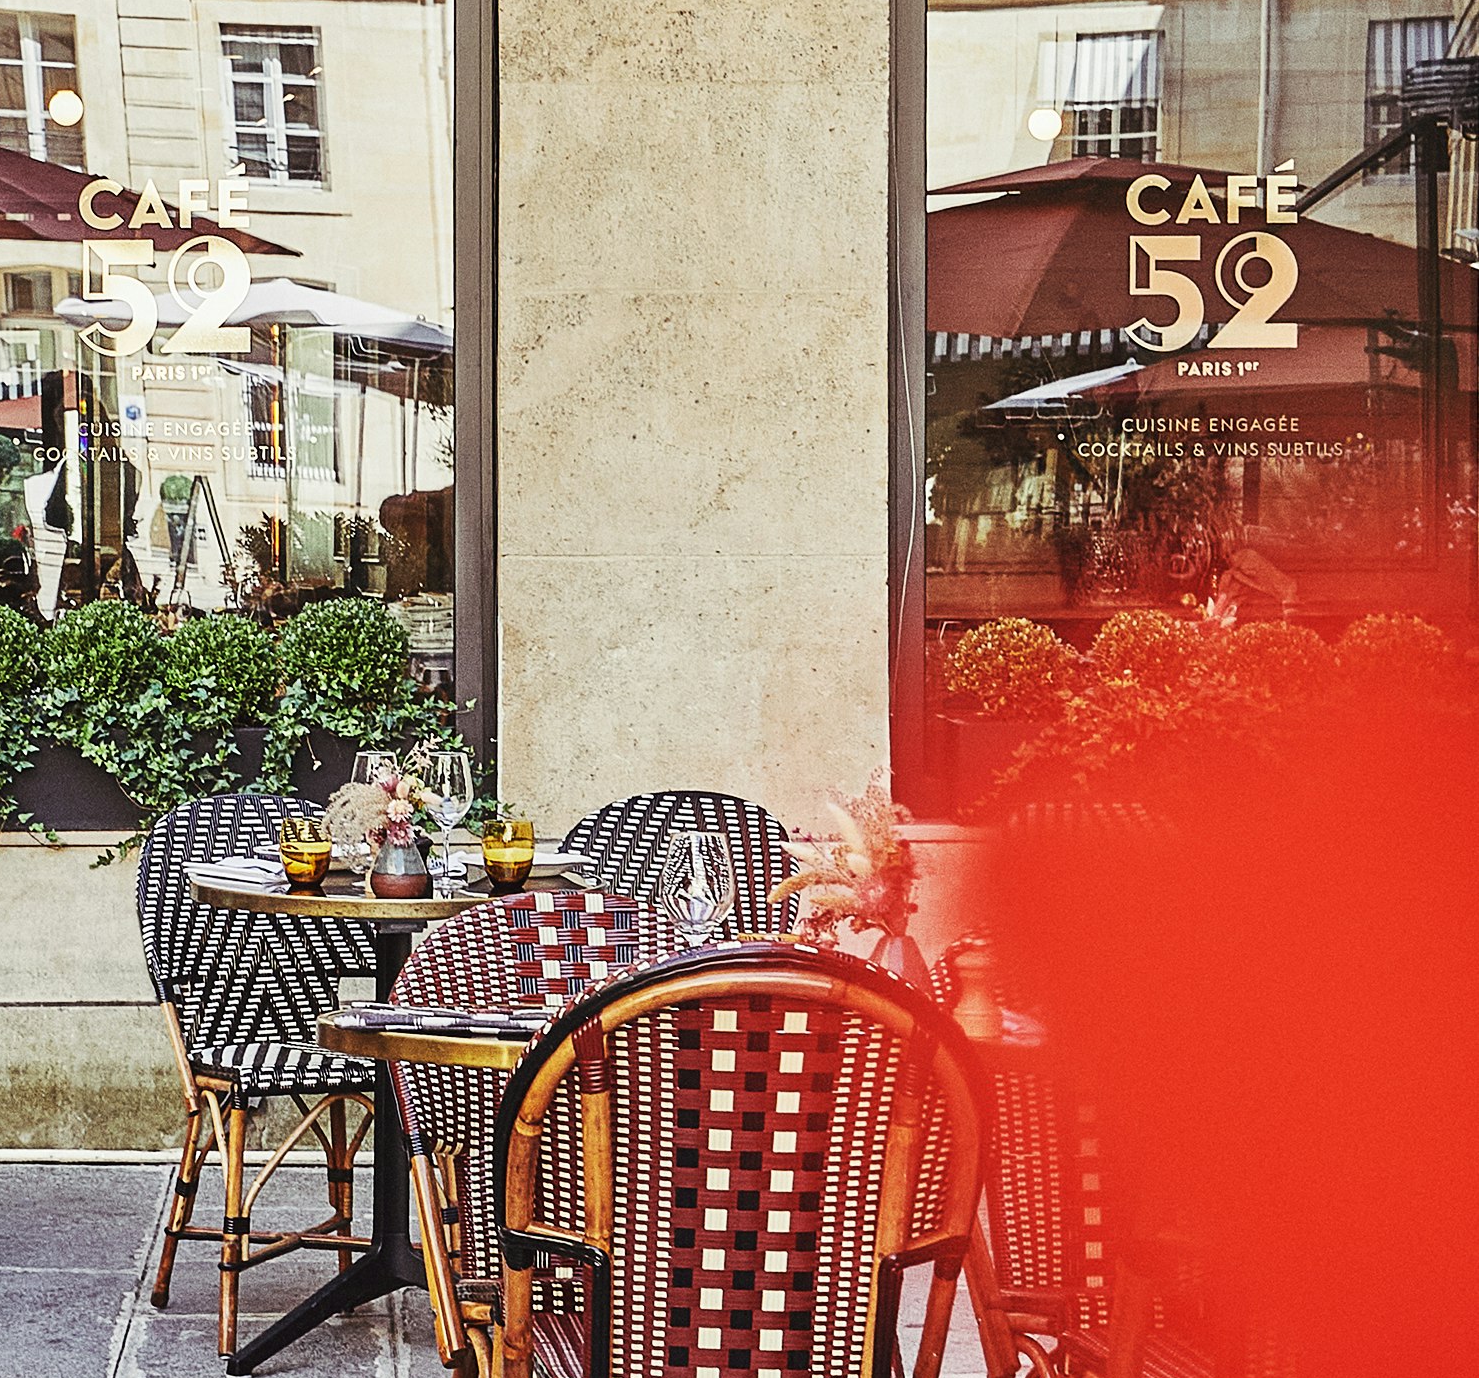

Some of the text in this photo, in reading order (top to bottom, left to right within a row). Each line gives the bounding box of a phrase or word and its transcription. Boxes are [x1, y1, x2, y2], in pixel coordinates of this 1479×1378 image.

[78, 162, 250, 231] CAFÉ
[1125, 158, 1298, 226] CAFÉ
[78, 235, 252, 357] 52
[1124, 231, 1299, 352] 52
[131, 366, 186, 381] PARIS
[1177, 361, 1233, 376] PARIS
[78, 419, 253, 437] CUISINE ENGAGÉE
[1122, 415, 1299, 433] CUISINE ENGAGÉE
[147, 447, 160, 462] &
[168, 447, 214, 462] VINS
[1077, 442, 1343, 458] COCKTAILS & VINS SUBTILS
